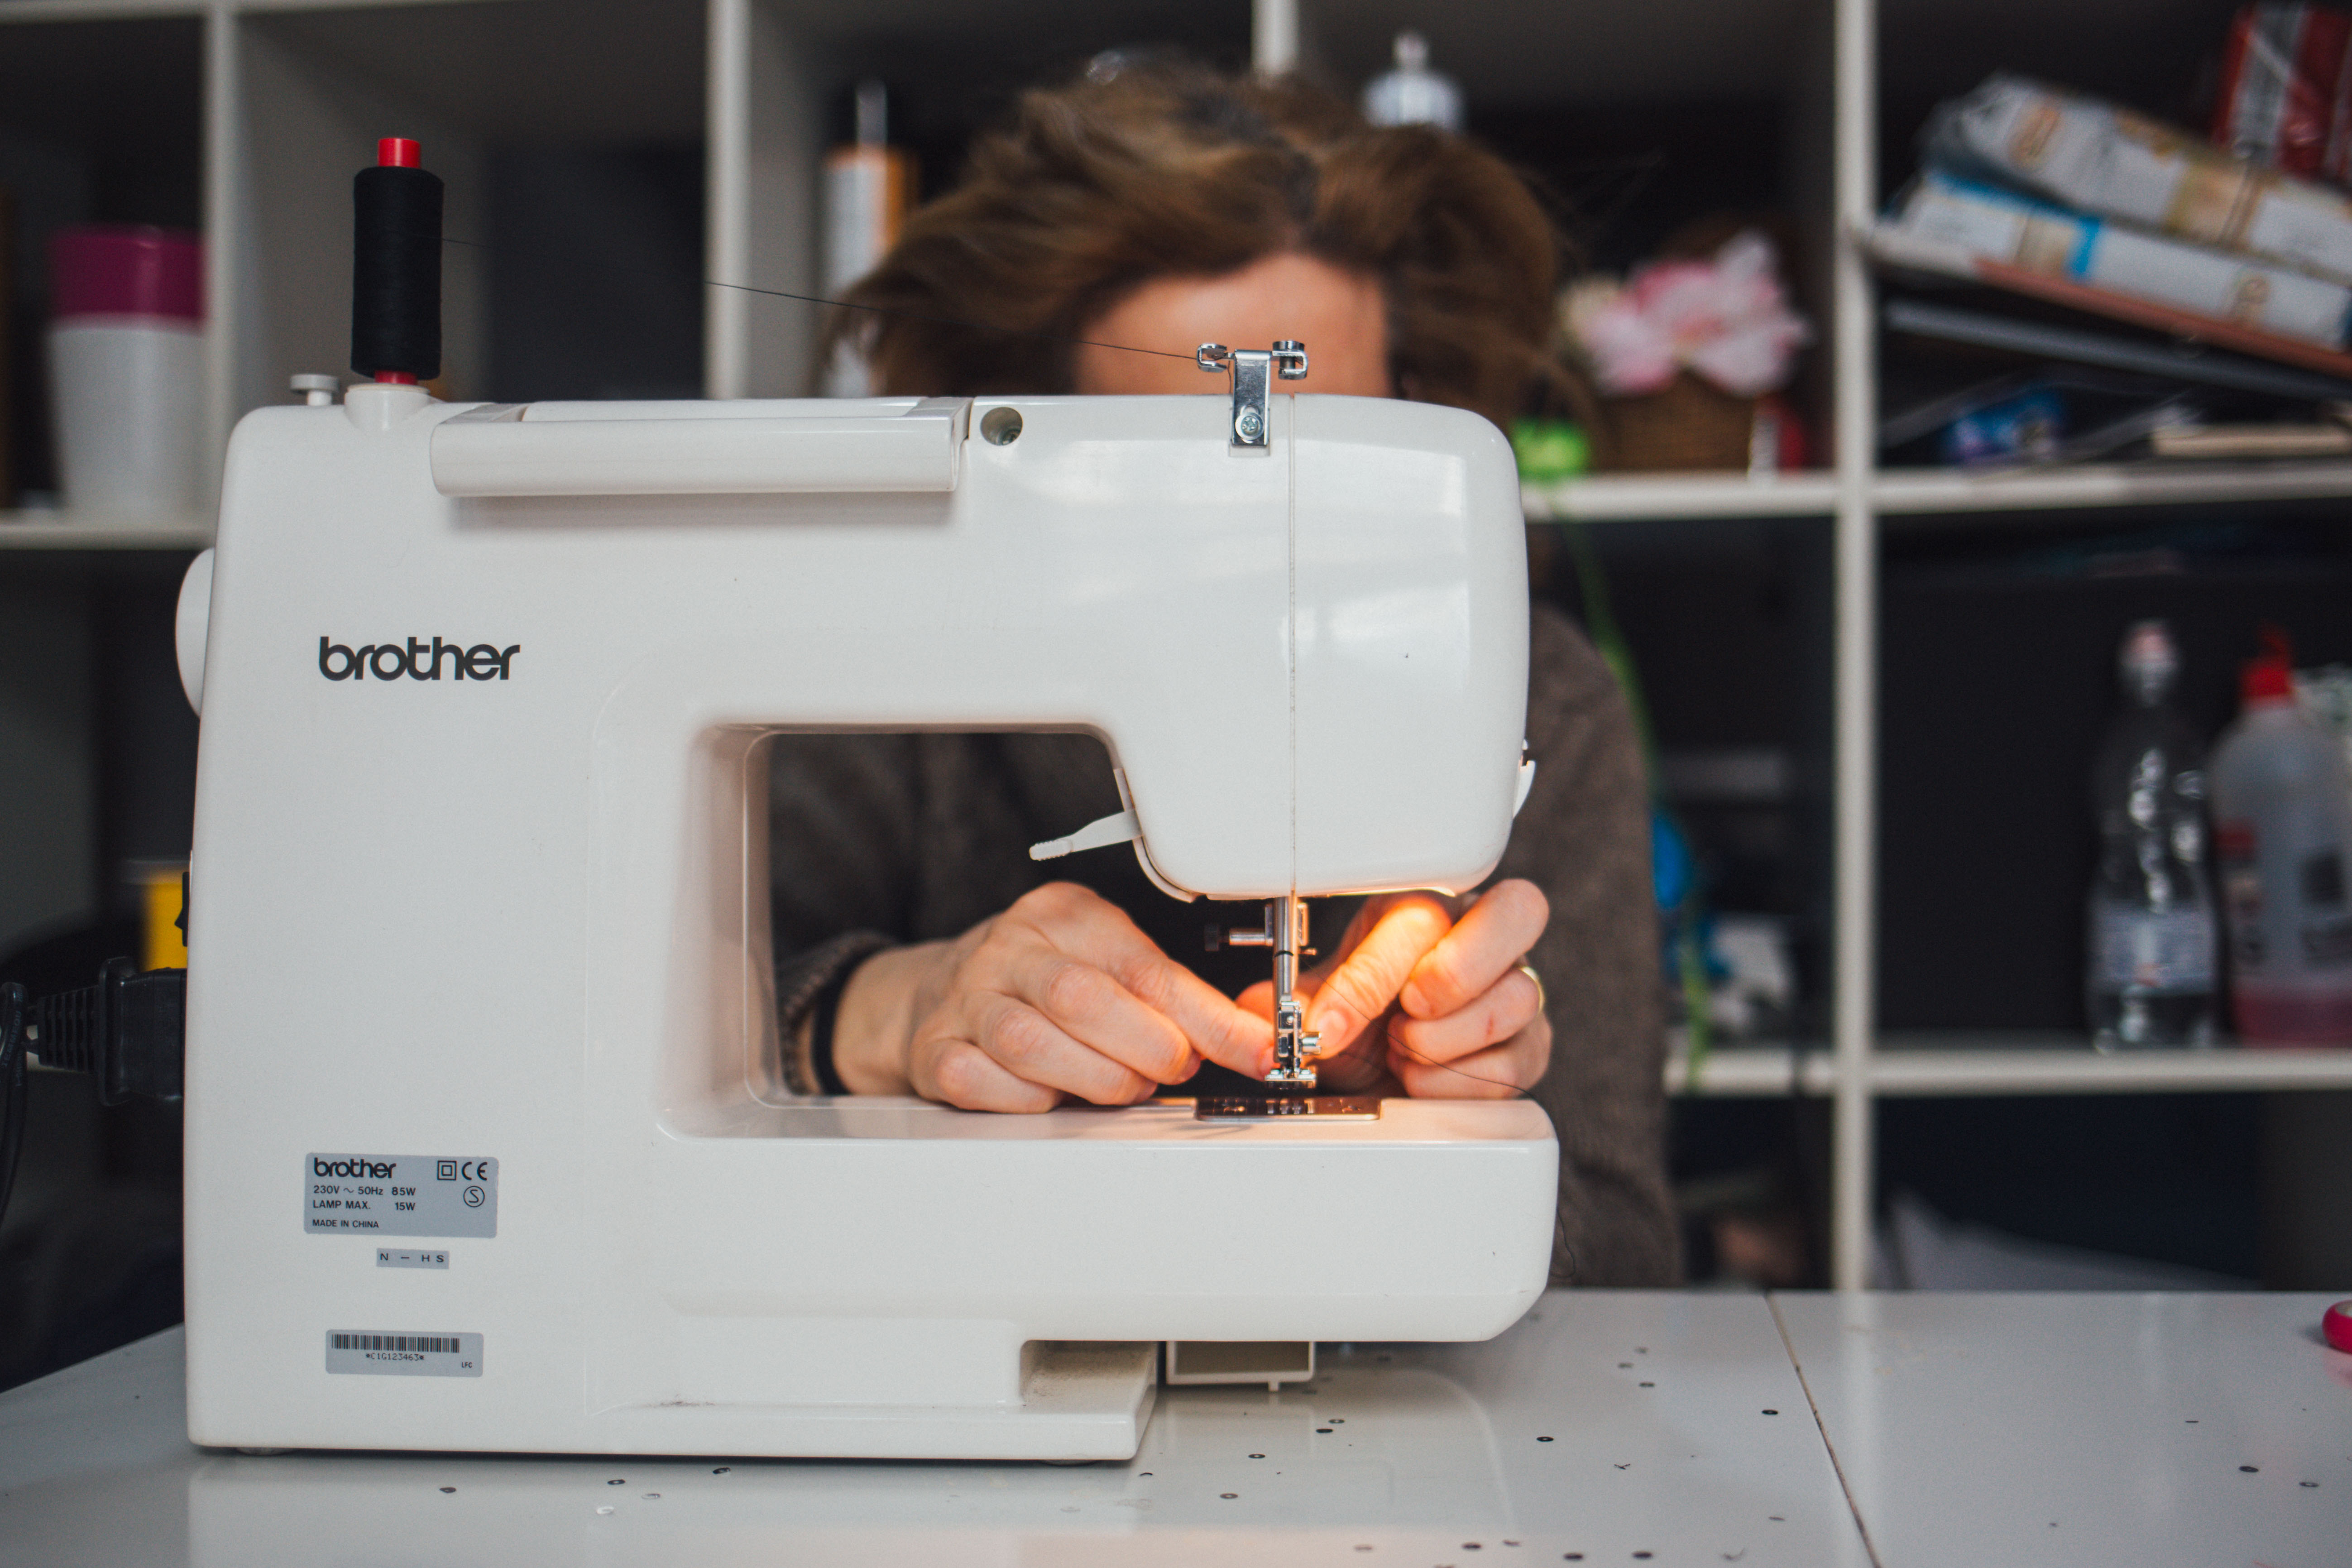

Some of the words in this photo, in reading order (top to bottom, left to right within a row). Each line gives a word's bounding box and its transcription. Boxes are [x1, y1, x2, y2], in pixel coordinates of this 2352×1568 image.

[319, 636, 520, 681] brother
[314, 1157, 397, 1179] brother
[314, 1185, 340, 1194] 230V
[358, 1186, 383, 1195] 50Hz
[391, 1186, 416, 1196] 85W
[313, 1200, 342, 1208] LAMP
[345, 1201, 371, 1209] MAX.
[395, 1202, 416, 1211] 15W
